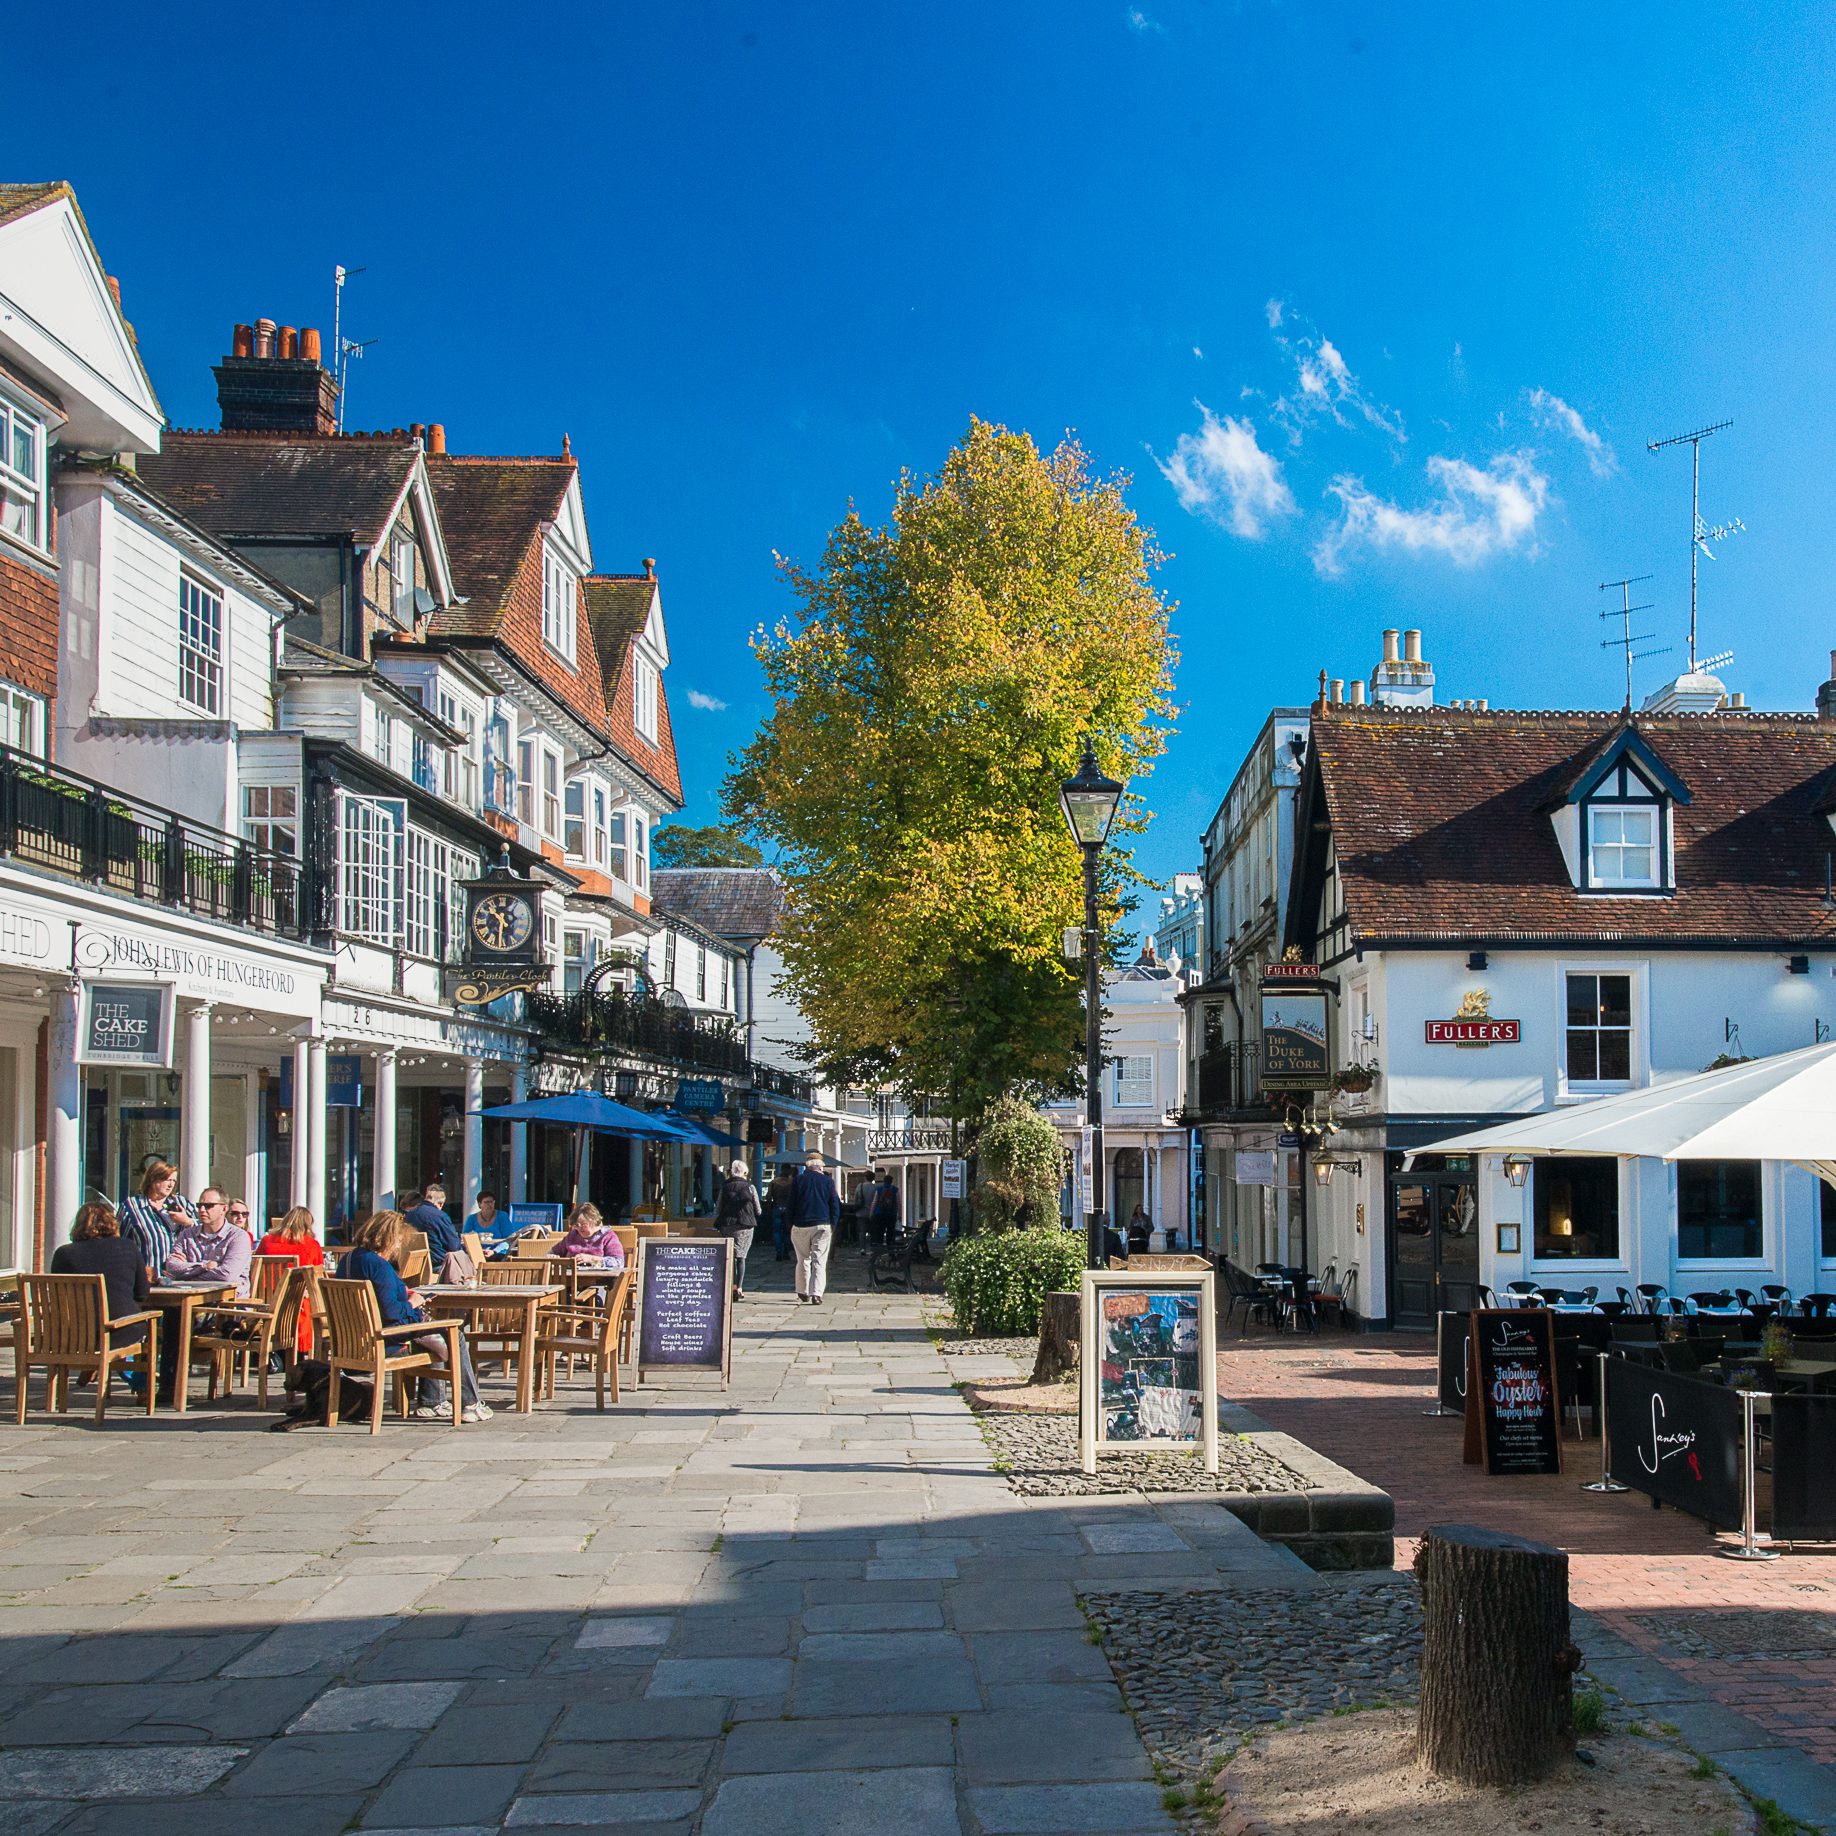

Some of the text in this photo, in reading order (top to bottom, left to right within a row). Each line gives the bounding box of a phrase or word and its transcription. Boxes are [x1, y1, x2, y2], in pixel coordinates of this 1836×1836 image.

[111, 935, 295, 994] JOHN LEWIS OF HUNGERFORD
[1267, 965, 1317, 975] FULLER'S
[519, 969, 547, 980] Clock
[95, 1003, 129, 1018] THE
[95, 1018, 148, 1033] CAKE
[1432, 1023, 1513, 1040] FULLER'S
[93, 1032, 140, 1048] SHED
[1269, 1045, 1304, 1057] DUKE
[1288, 1057, 1320, 1069] YORK
[683, 1086, 718, 1094] PANTILES
[1495, 1366, 1539, 1380] Fabulous
[1493, 1380, 1543, 1409] Oyster
[1496, 1405, 1543, 1421] Happy Hour
